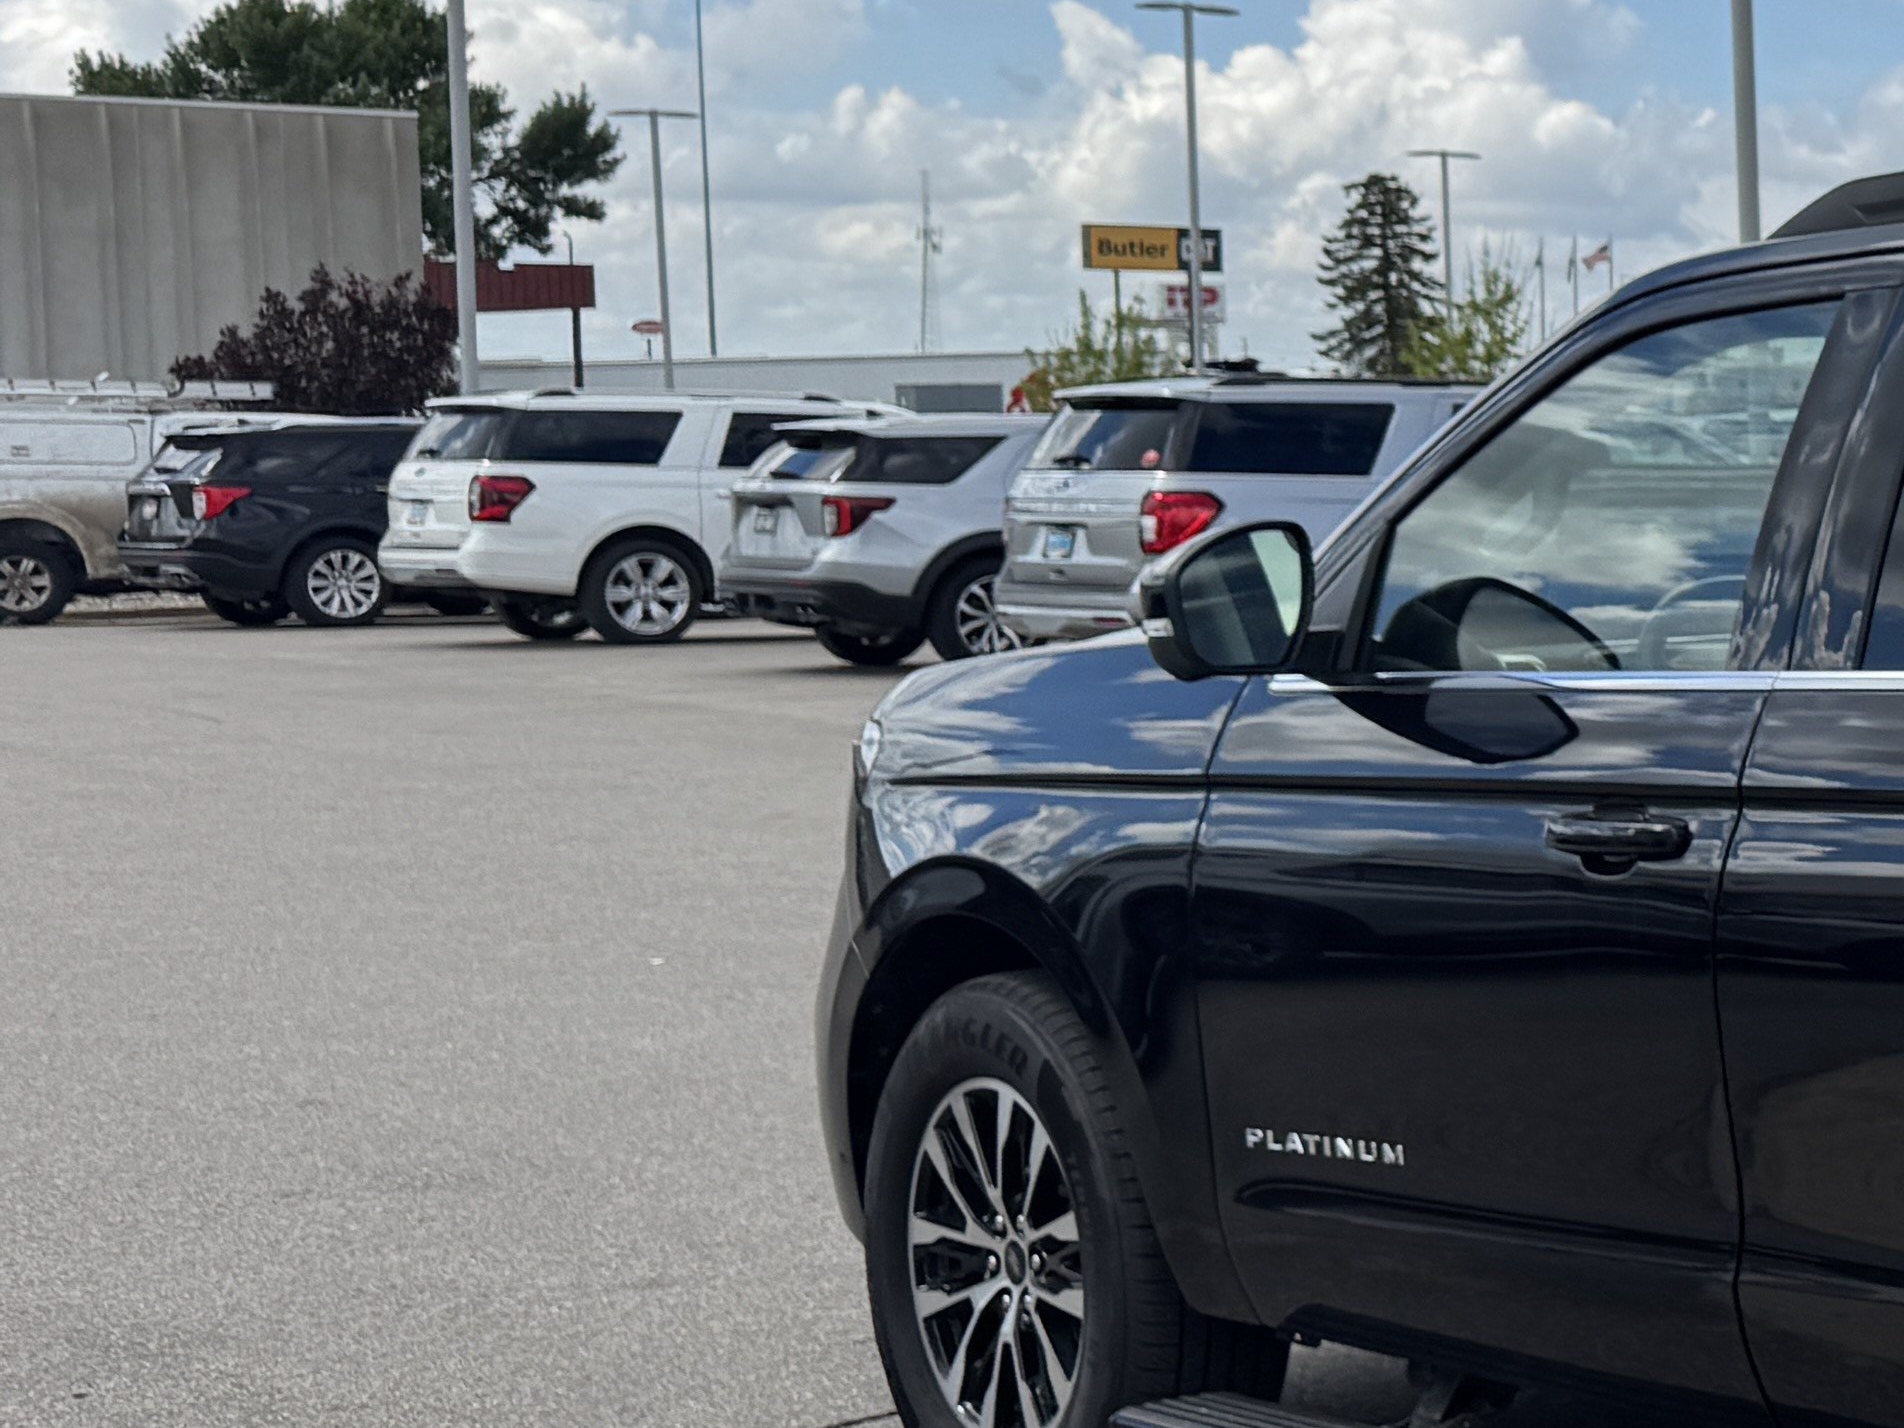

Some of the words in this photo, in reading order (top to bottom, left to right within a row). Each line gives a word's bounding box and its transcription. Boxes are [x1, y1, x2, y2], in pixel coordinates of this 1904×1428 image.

[1097, 236, 1169, 258] Butler
[1180, 236, 1216, 263] CT
[1244, 1126, 1405, 1166] PLATINUM
